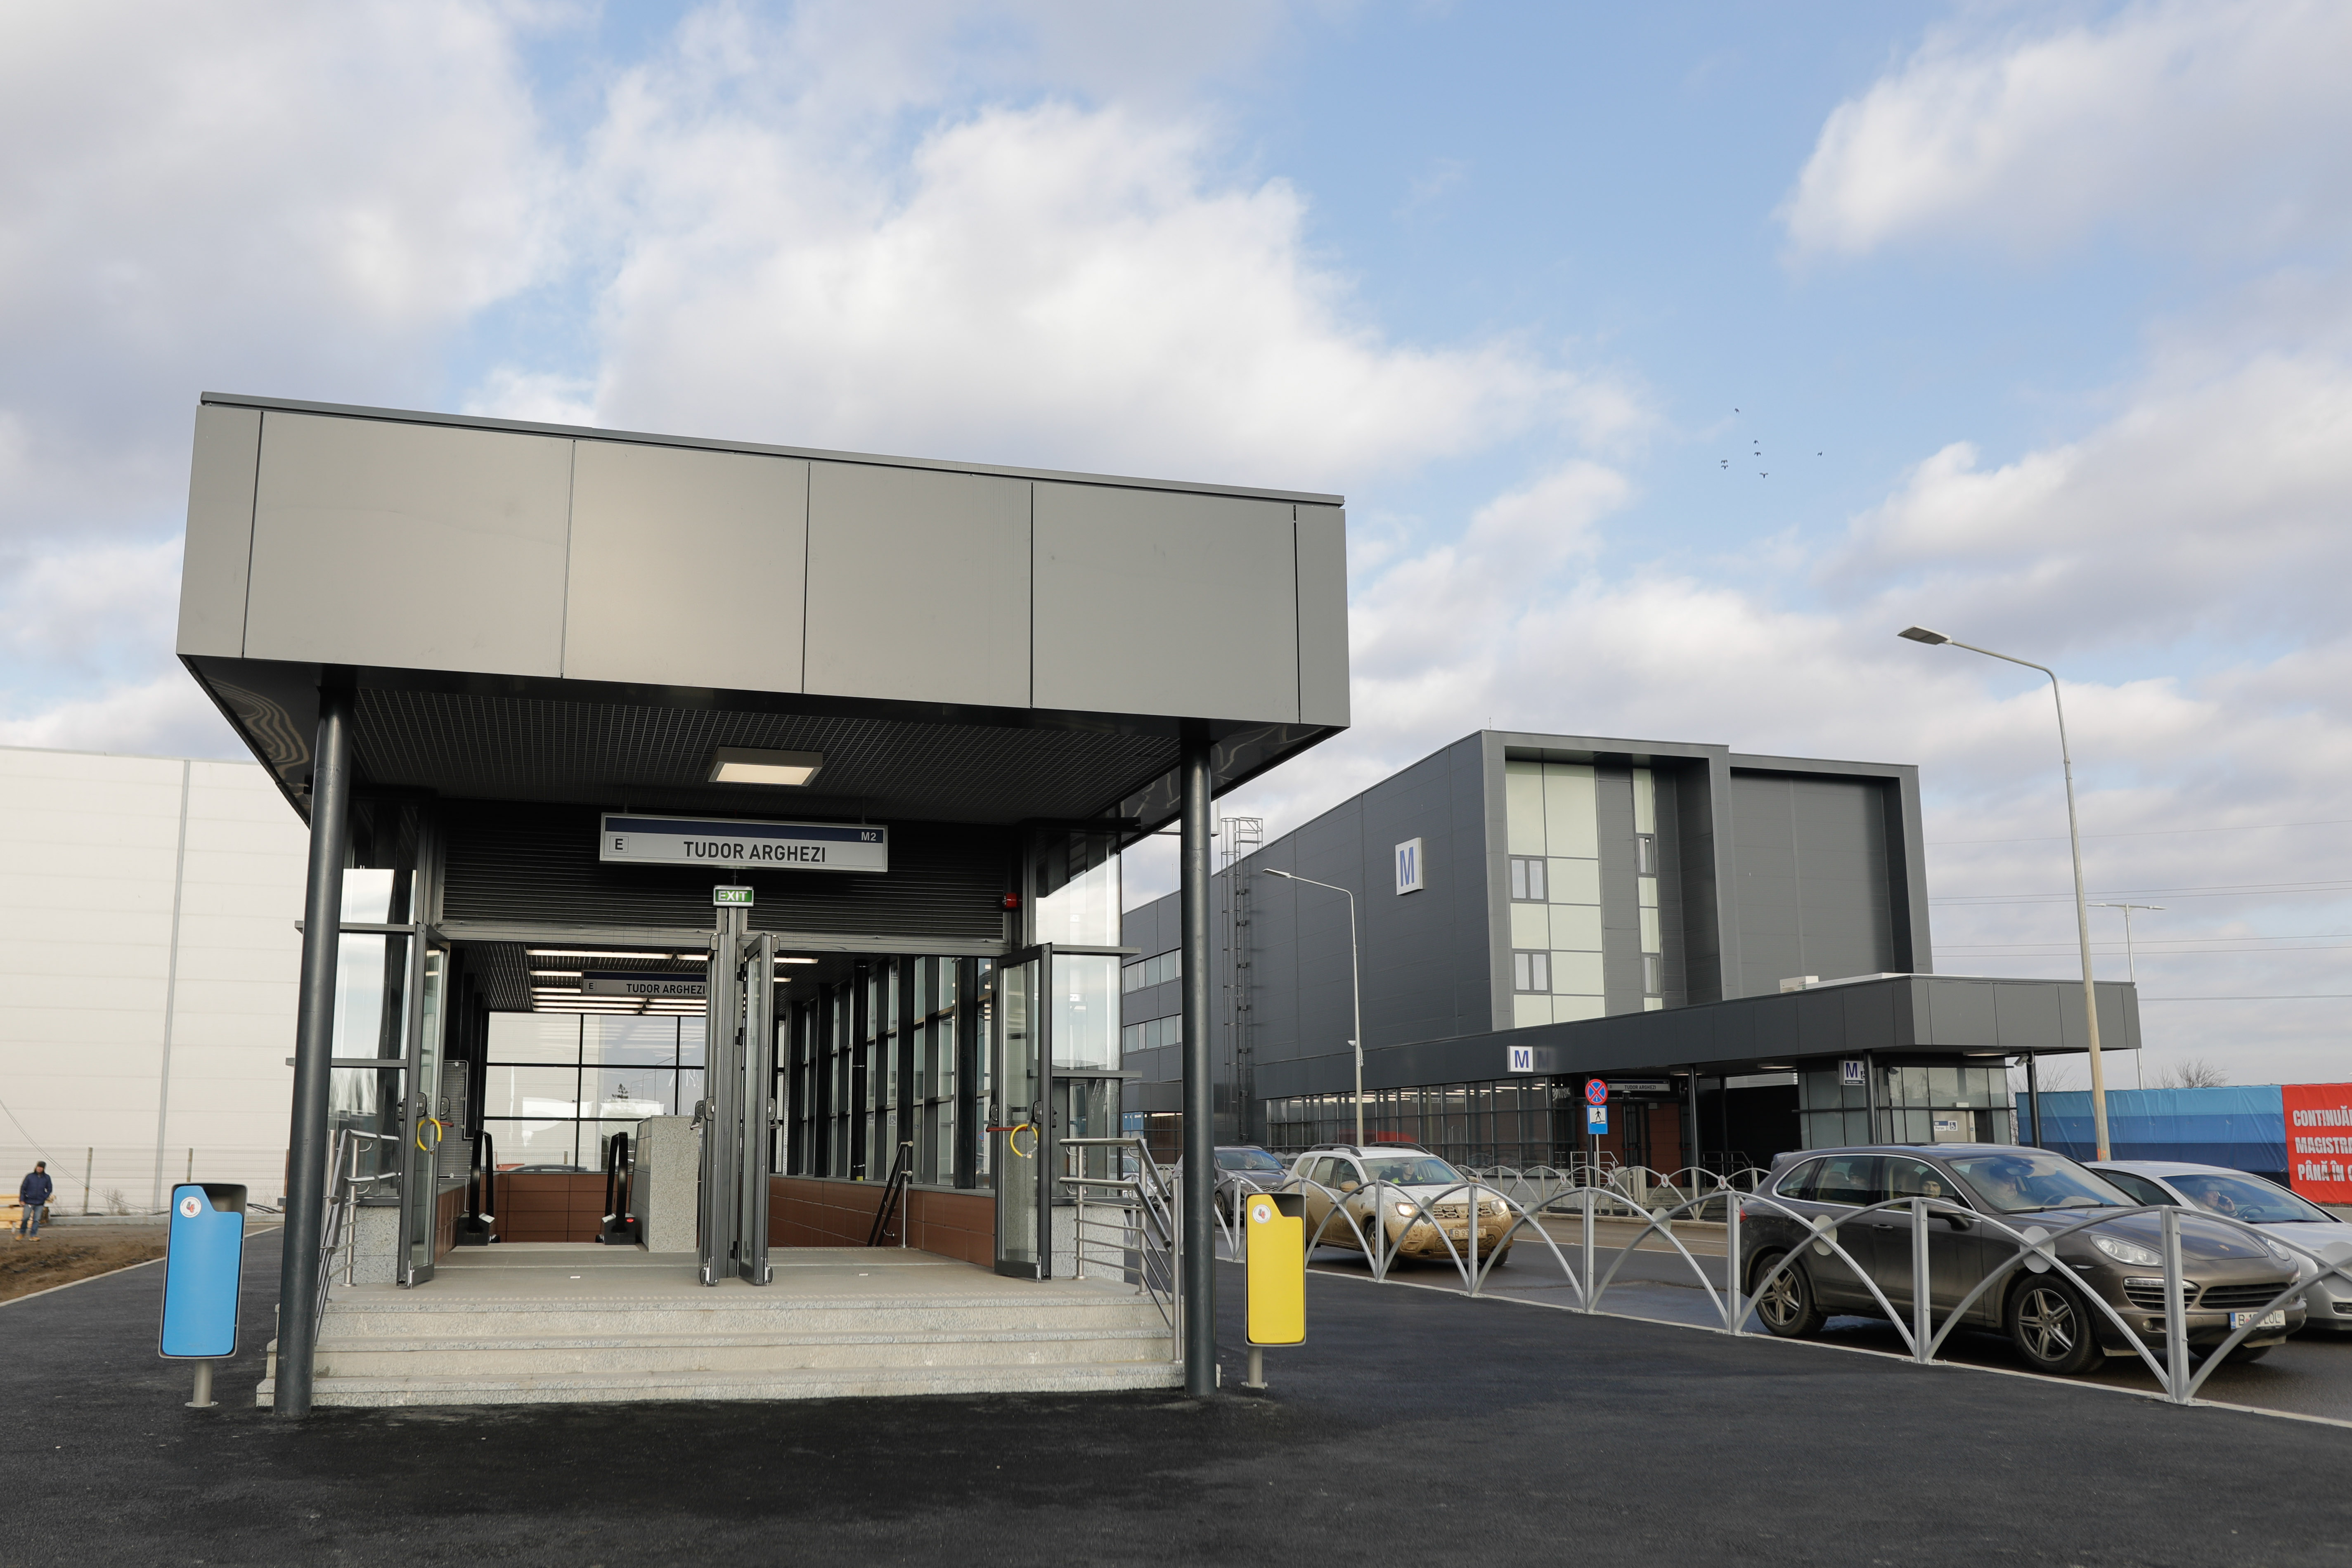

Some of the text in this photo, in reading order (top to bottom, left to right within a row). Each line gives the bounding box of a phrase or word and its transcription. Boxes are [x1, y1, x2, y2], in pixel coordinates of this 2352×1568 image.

[861, 832, 876, 841] M2
[615, 838, 825, 862] E TUDOR ARGHEZI
[1400, 847, 1415, 887] M
[718, 891, 748, 901] EXIT
[627, 984, 660, 993] TUDOR
[663, 985, 705, 994] ARGHEZI
[1514, 1050, 1529, 1068] M
[1846, 1062, 1858, 1078] M
[2298, 1160, 2330, 1181] PÂNĂ
[2330, 1160, 2345, 1182] ÎN
[2238, 1314, 2245, 1326] B
